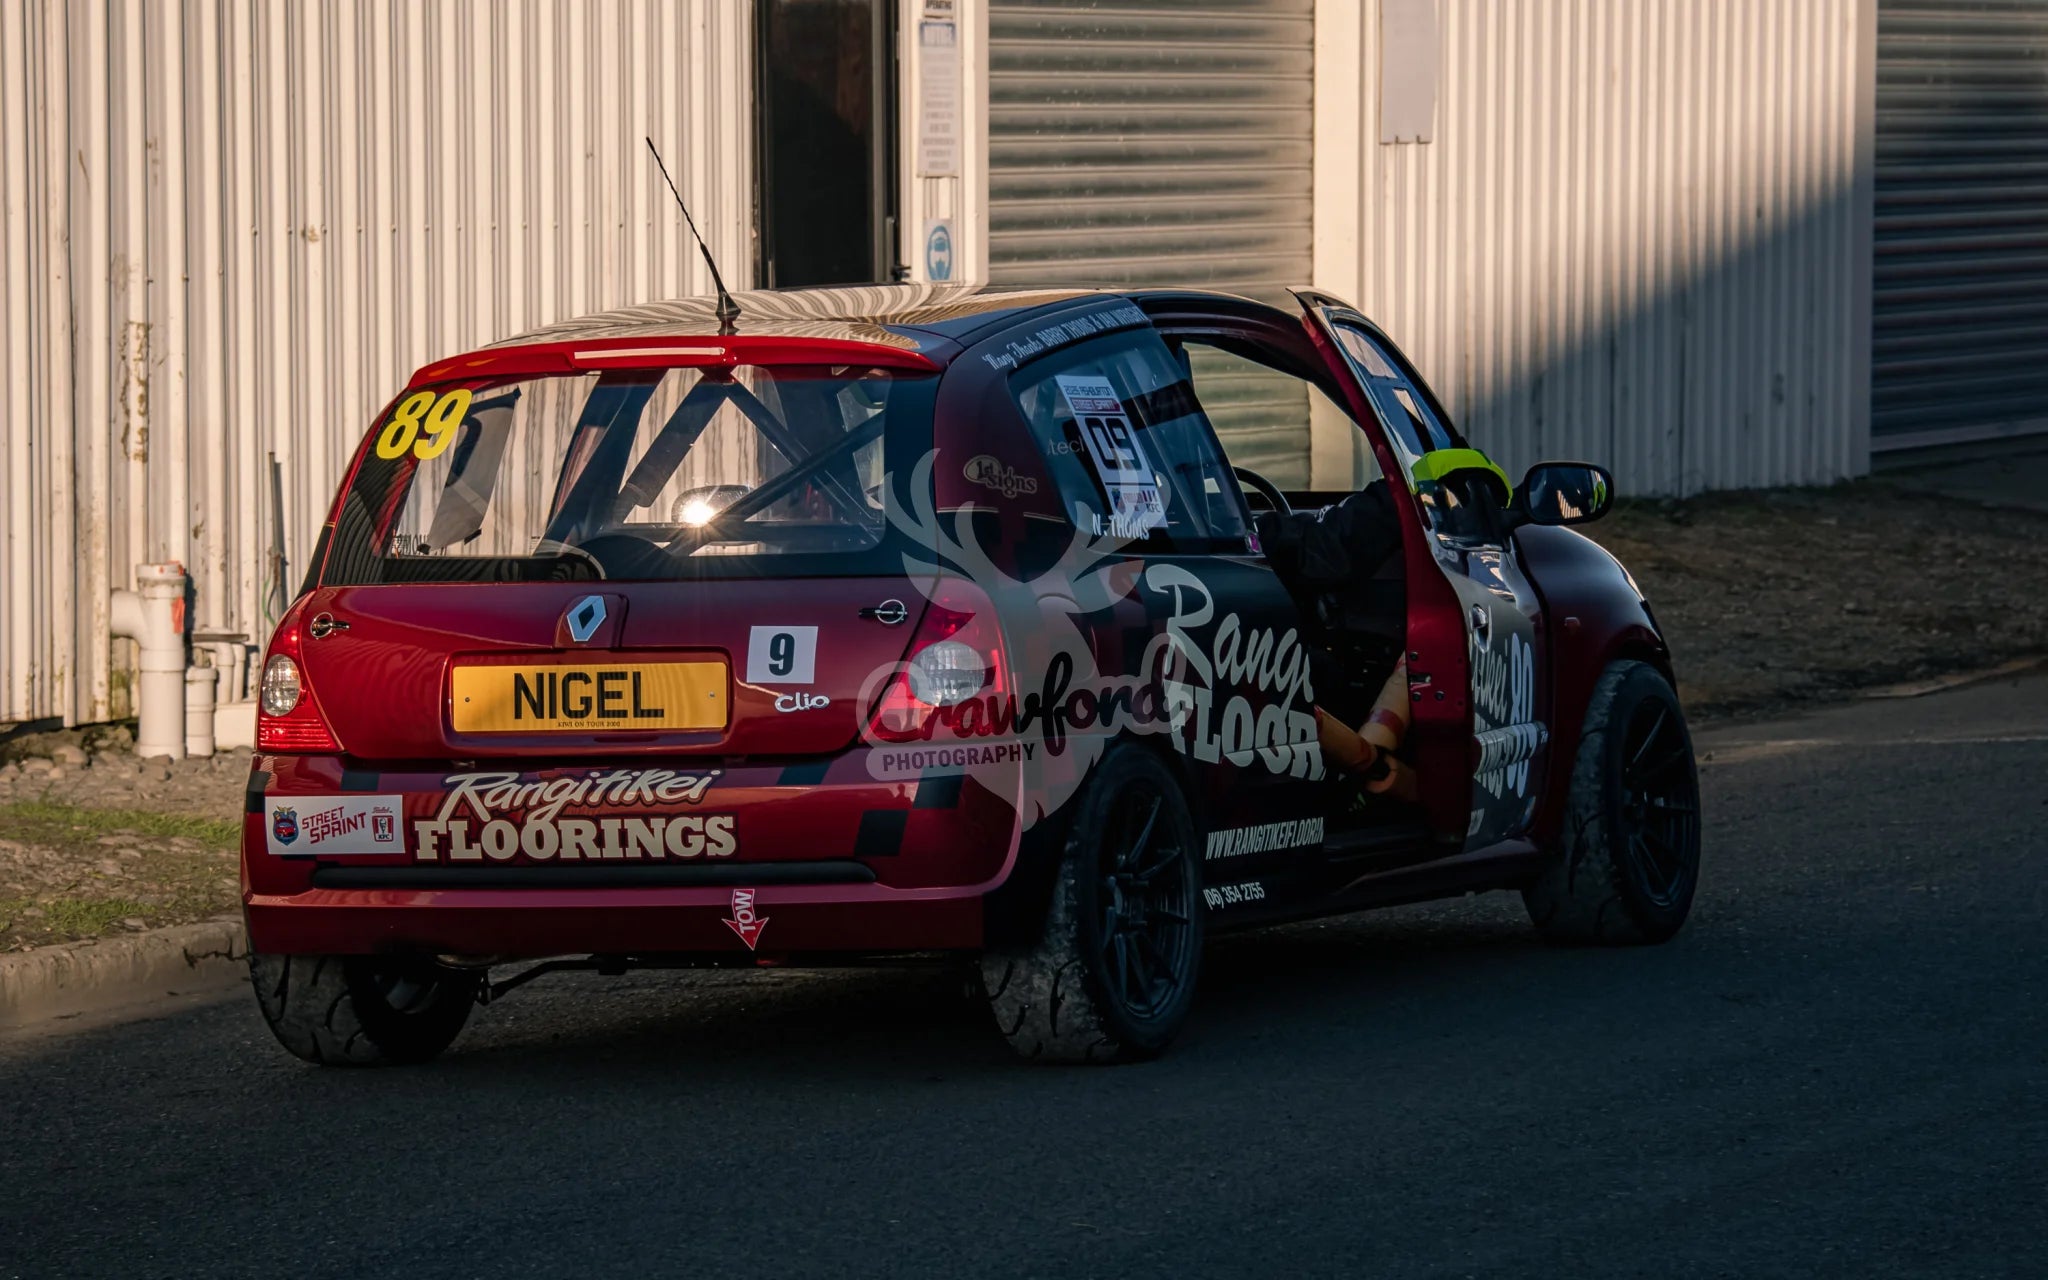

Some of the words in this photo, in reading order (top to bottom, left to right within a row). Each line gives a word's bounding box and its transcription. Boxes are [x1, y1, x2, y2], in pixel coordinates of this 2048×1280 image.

[376, 388, 472, 460] 89
[1085, 417, 1143, 470] 09
[1108, 510, 1150, 540] THOMS
[768, 633, 795, 676] 9
[514, 671, 664, 720] NIGEL
[774, 692, 830, 713] Clio
[302, 806, 344, 829] STREET
[310, 812, 366, 844] SPRINT
[414, 816, 736, 860] FLOORINGS
[735, 891, 756, 934] TOW
[1203, 888, 1225, 910] (06)
[1221, 885, 1243, 903] 354
[1240, 881, 1265, 901] 2755
